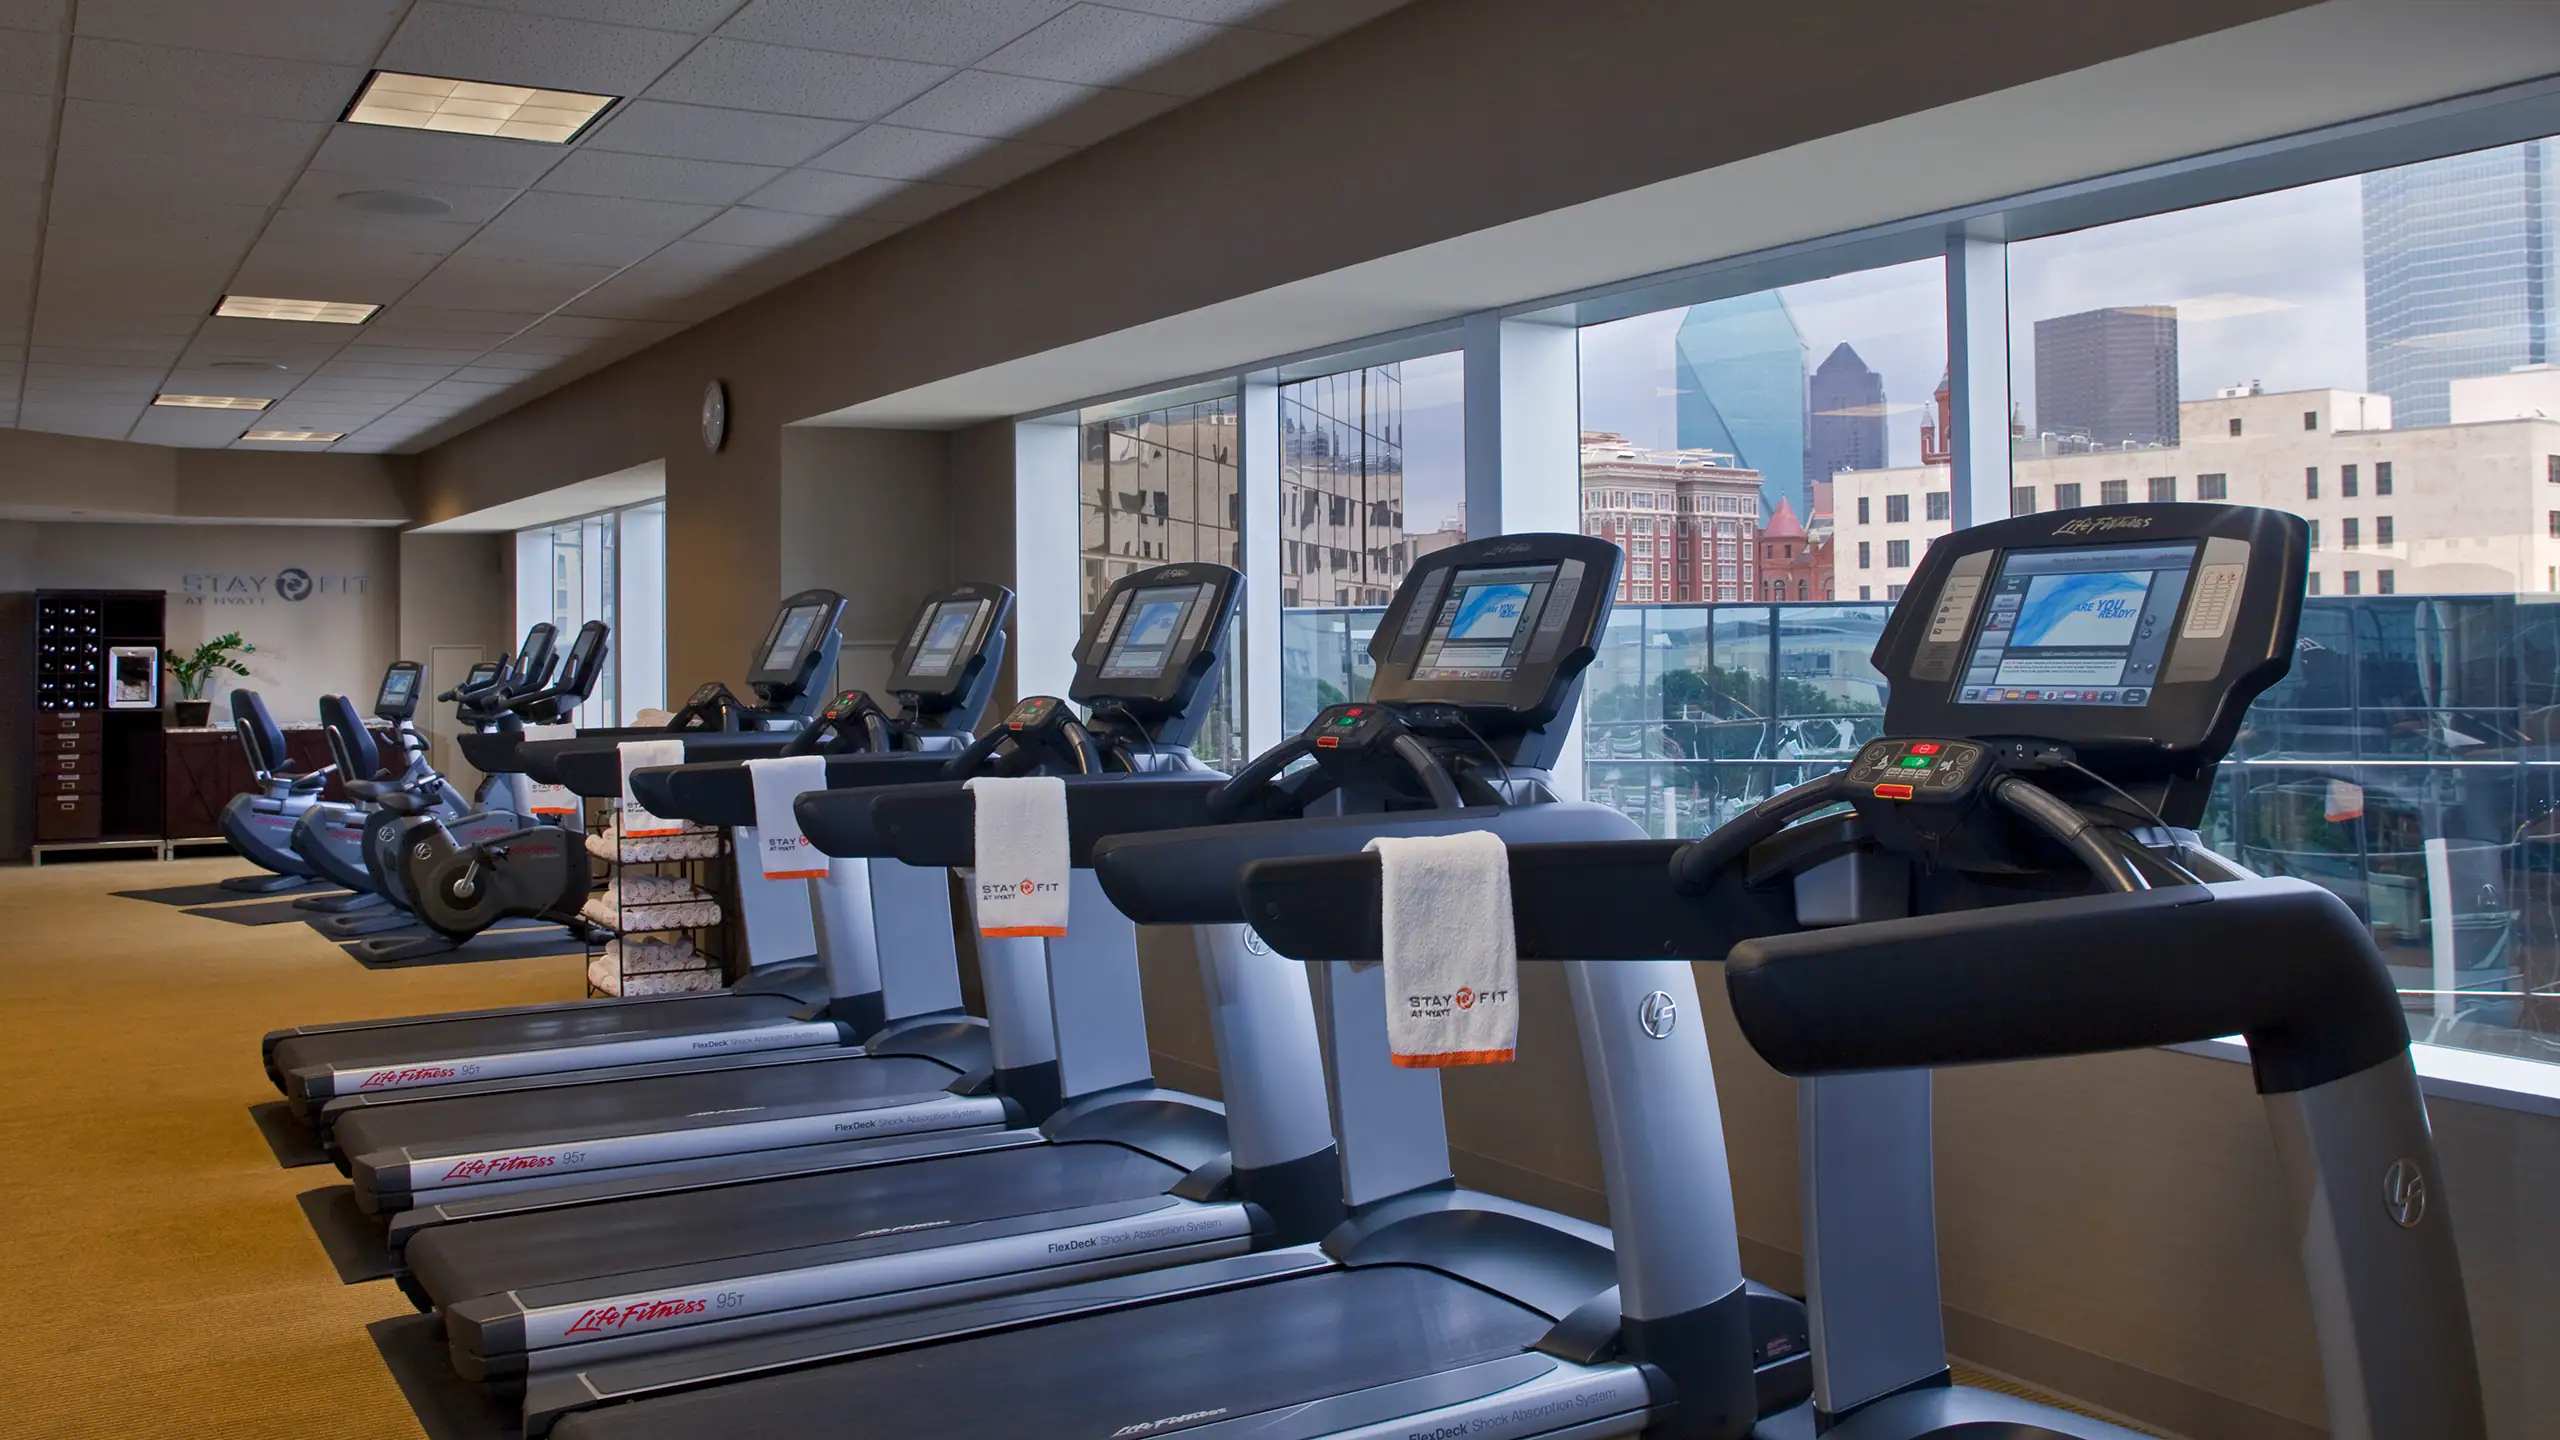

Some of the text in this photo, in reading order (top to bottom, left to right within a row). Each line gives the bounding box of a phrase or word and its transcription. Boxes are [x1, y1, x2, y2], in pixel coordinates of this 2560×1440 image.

[182, 573, 371, 594] STAY FIT
[2097, 599, 2126, 611] YOU
[2097, 608, 2137, 619] READY?
[769, 838, 796, 846] STAY
[982, 882, 1060, 894] STAY FIT
[1409, 990, 1508, 1008] STAY FIT
[1411, 1008, 1451, 1018] AT HYATT
[692, 1039, 728, 1049] FlexDeck
[360, 1070, 397, 1089] Life
[834, 1108, 982, 1132] FlexDeck Shock Absorption System
[441, 1159, 486, 1181] Life
[1048, 1218, 1222, 1254] FlexDeck Shock Absorption System
[563, 1306, 620, 1336] Life
[1472, 1415, 1509, 1432] Shock
[1511, 1401, 1574, 1422] Absorption
[1575, 1388, 1617, 1408] System
